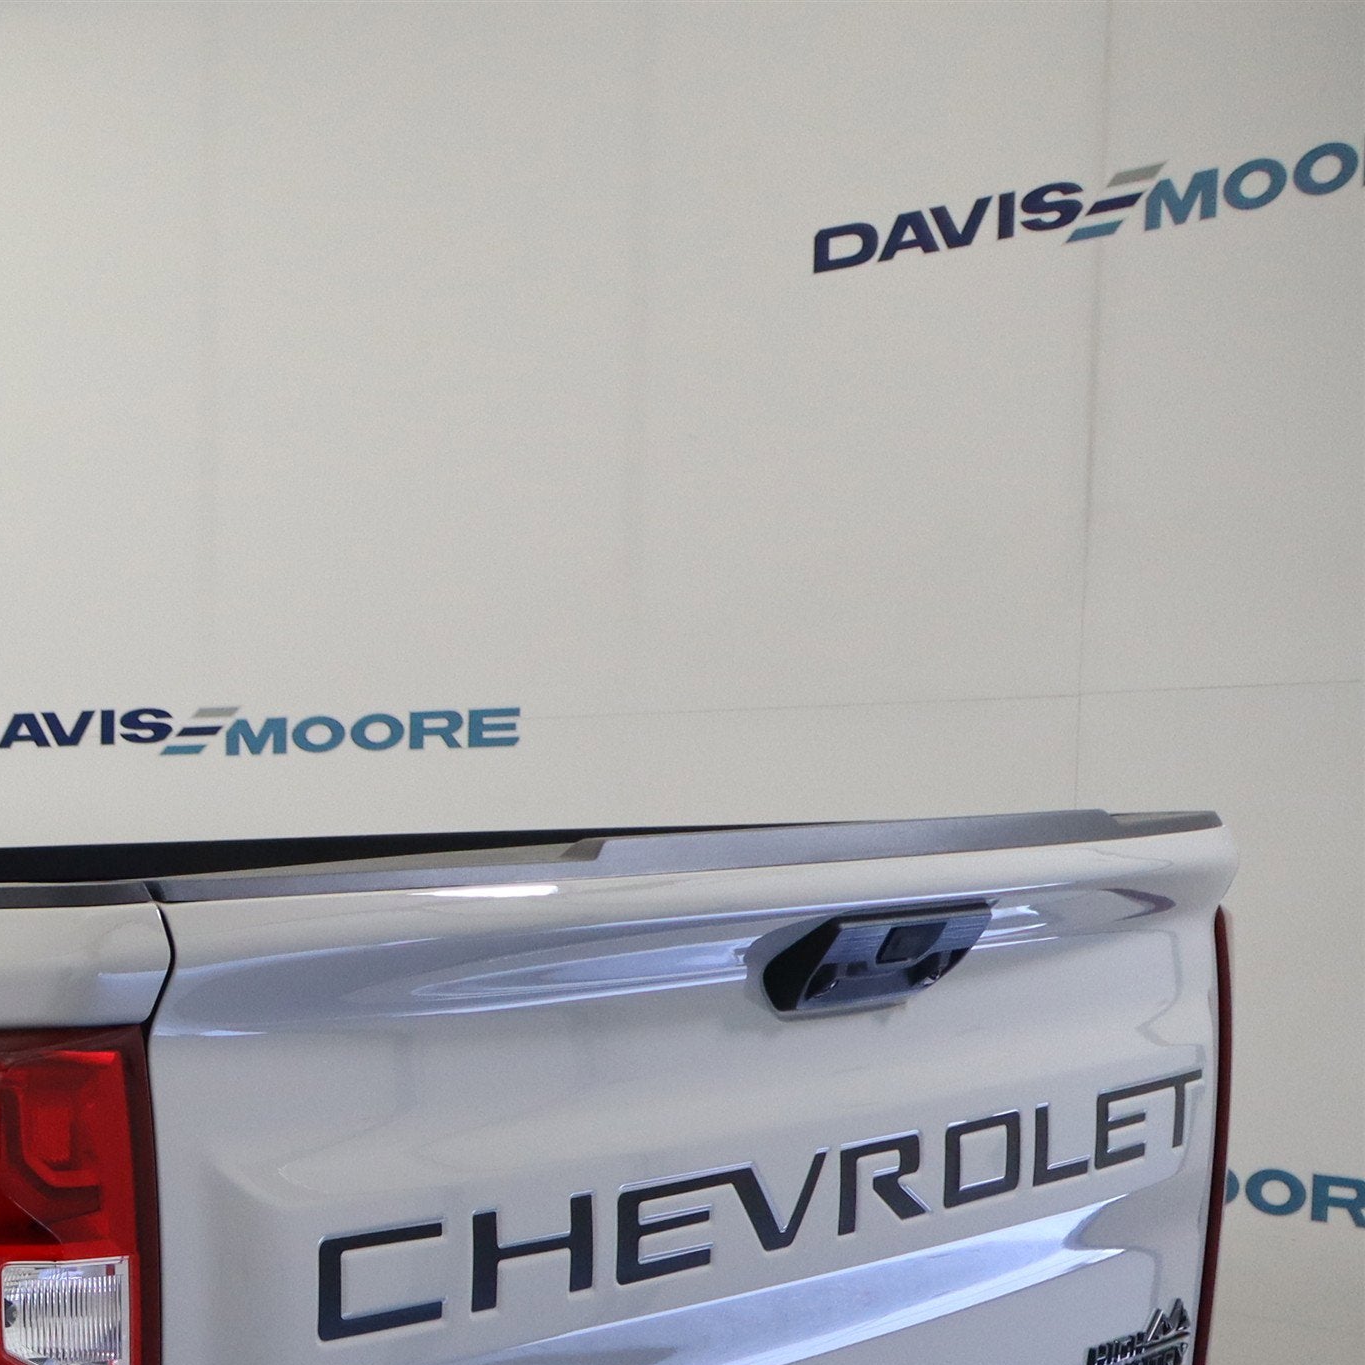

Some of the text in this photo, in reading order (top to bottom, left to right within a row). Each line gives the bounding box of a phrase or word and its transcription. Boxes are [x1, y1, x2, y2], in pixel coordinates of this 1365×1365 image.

[813, 136, 1365, 274] DAVIS MOO
[225, 707, 521, 756] MOORE
[317, 1068, 1204, 1342] CHEVROLET
